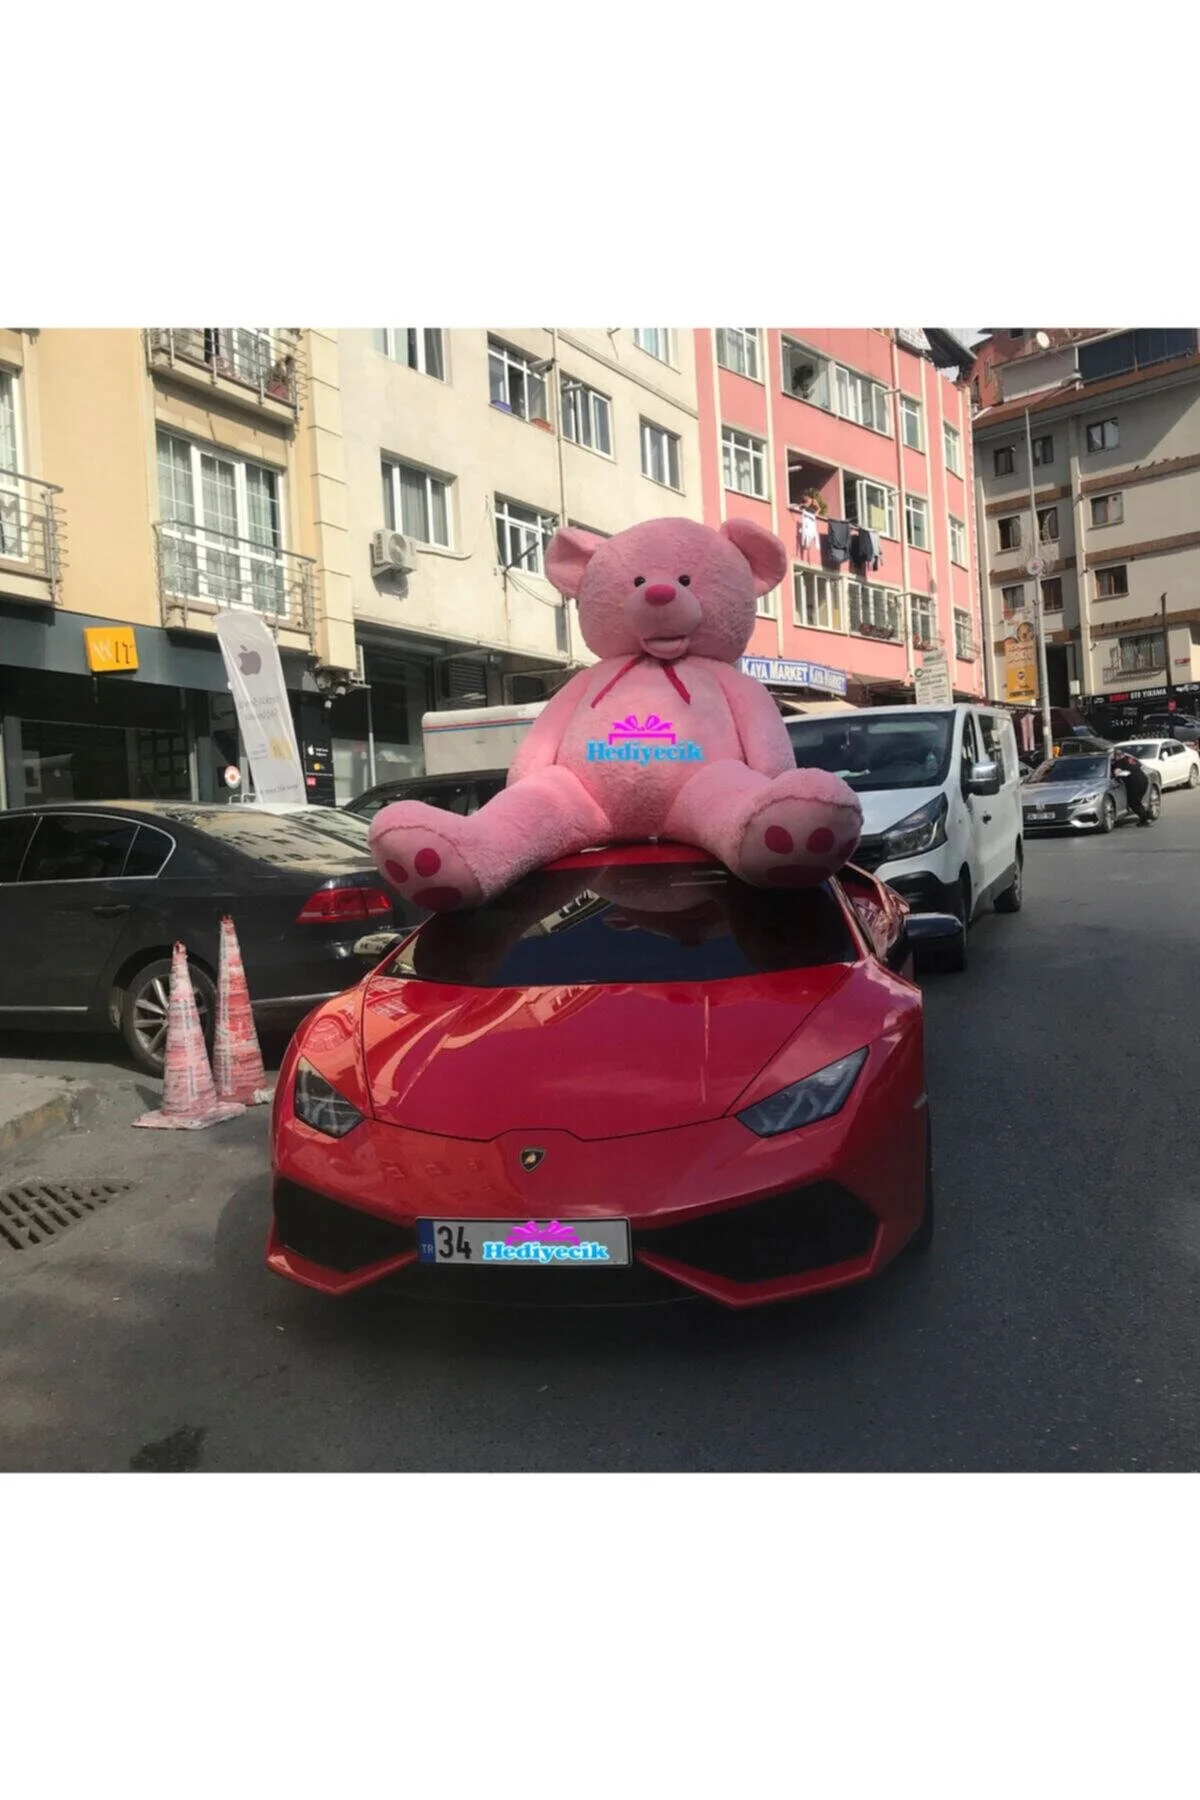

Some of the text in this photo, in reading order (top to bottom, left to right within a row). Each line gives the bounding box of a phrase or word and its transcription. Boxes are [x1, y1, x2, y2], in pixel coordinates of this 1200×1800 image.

[741, 658, 808, 682] KAYA MARKET
[421, 1243, 434, 1255] TR
[437, 1225, 473, 1260] 34
